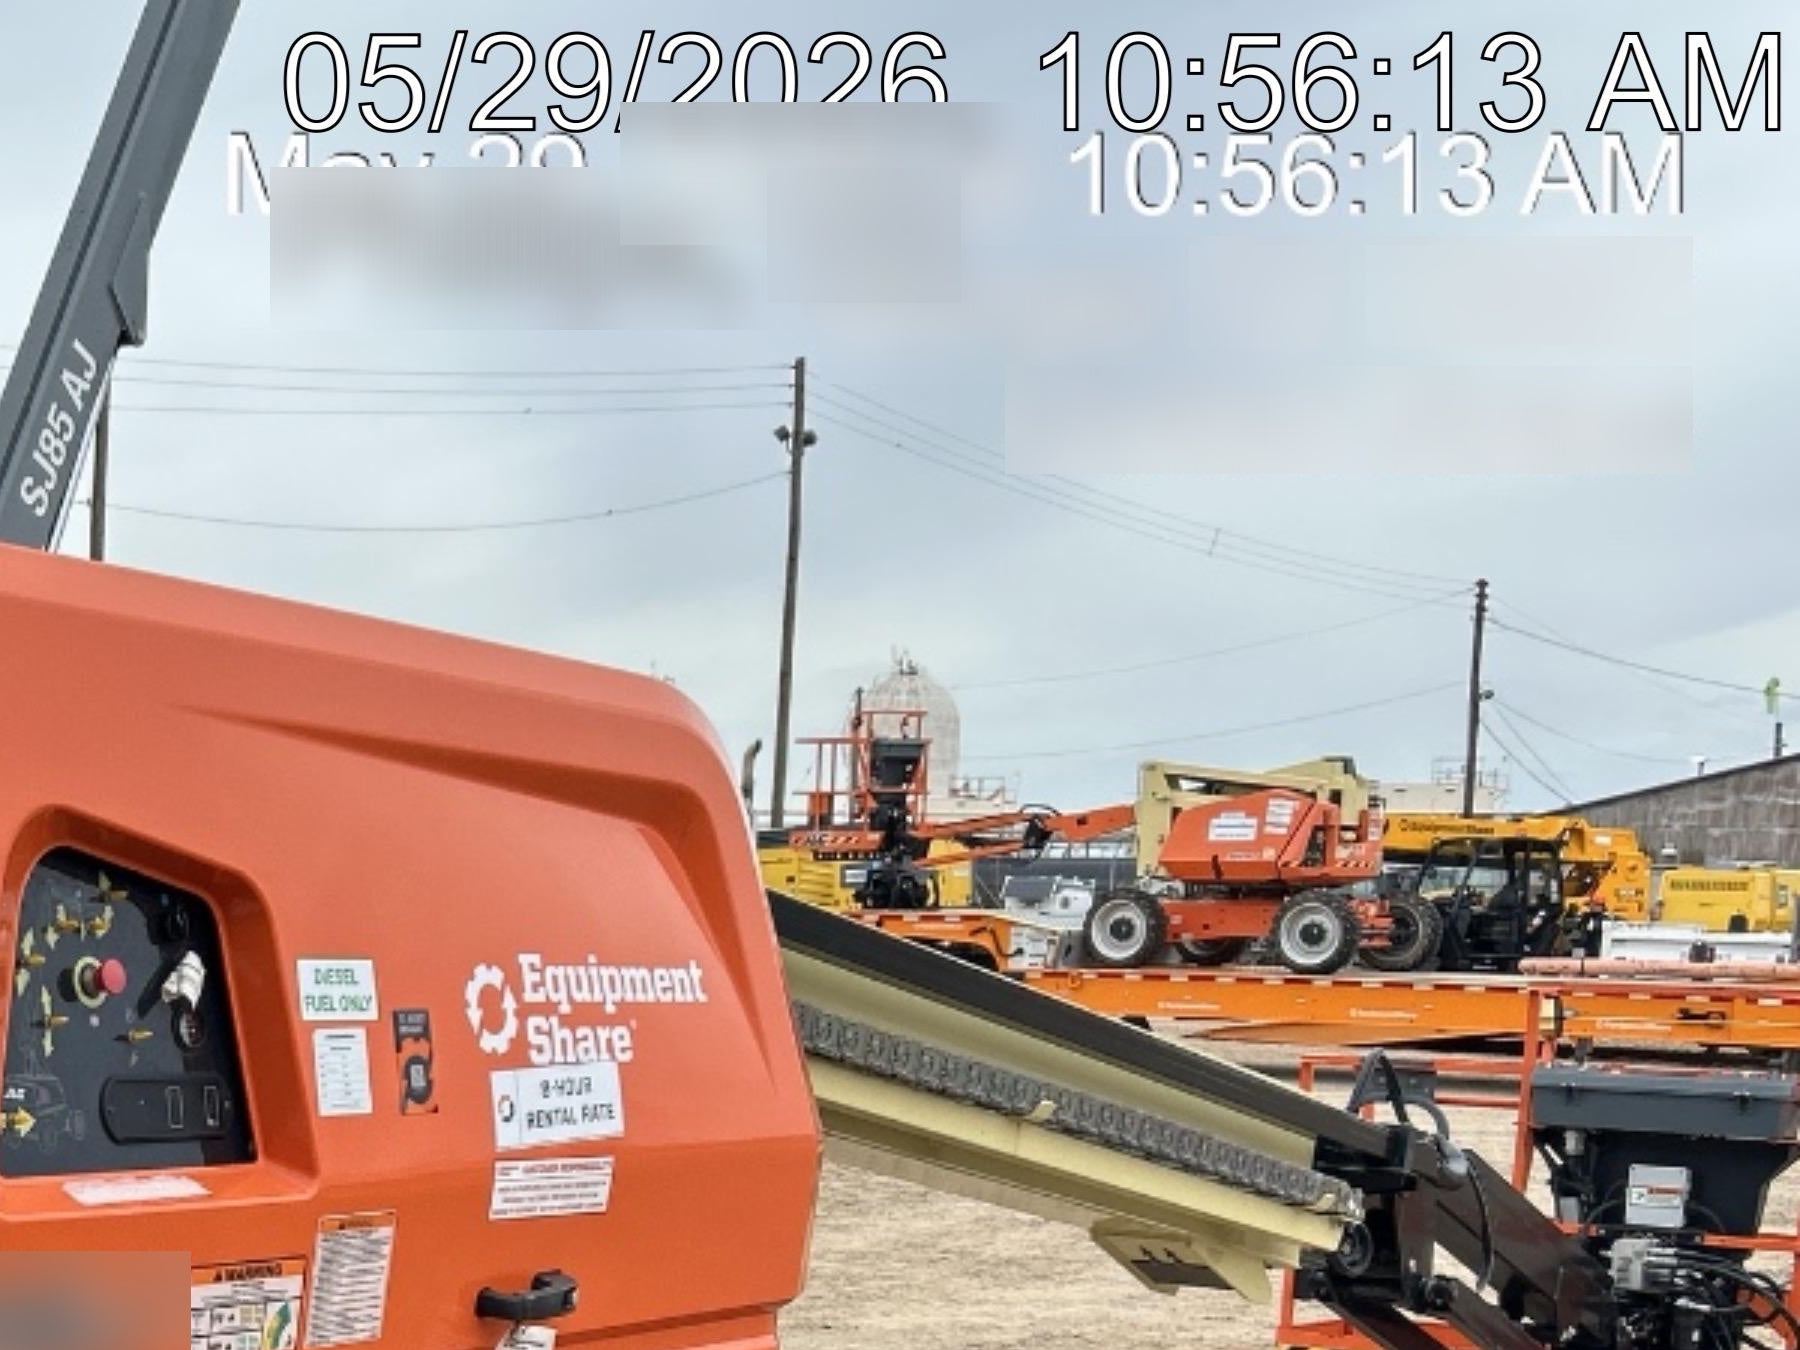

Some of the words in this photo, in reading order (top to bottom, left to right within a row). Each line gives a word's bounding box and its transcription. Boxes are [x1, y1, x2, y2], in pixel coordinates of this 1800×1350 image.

[20, 401, 76, 517] SJ85
[61, 337, 97, 412] AJ
[314, 967, 360, 985] DIESEL
[517, 952, 709, 1015] Equipment
[304, 994, 337, 1012] FUEL
[526, 1014, 634, 1066] Share
[526, 1106, 577, 1130] RENTAL
[581, 1103, 616, 1122] RATE
